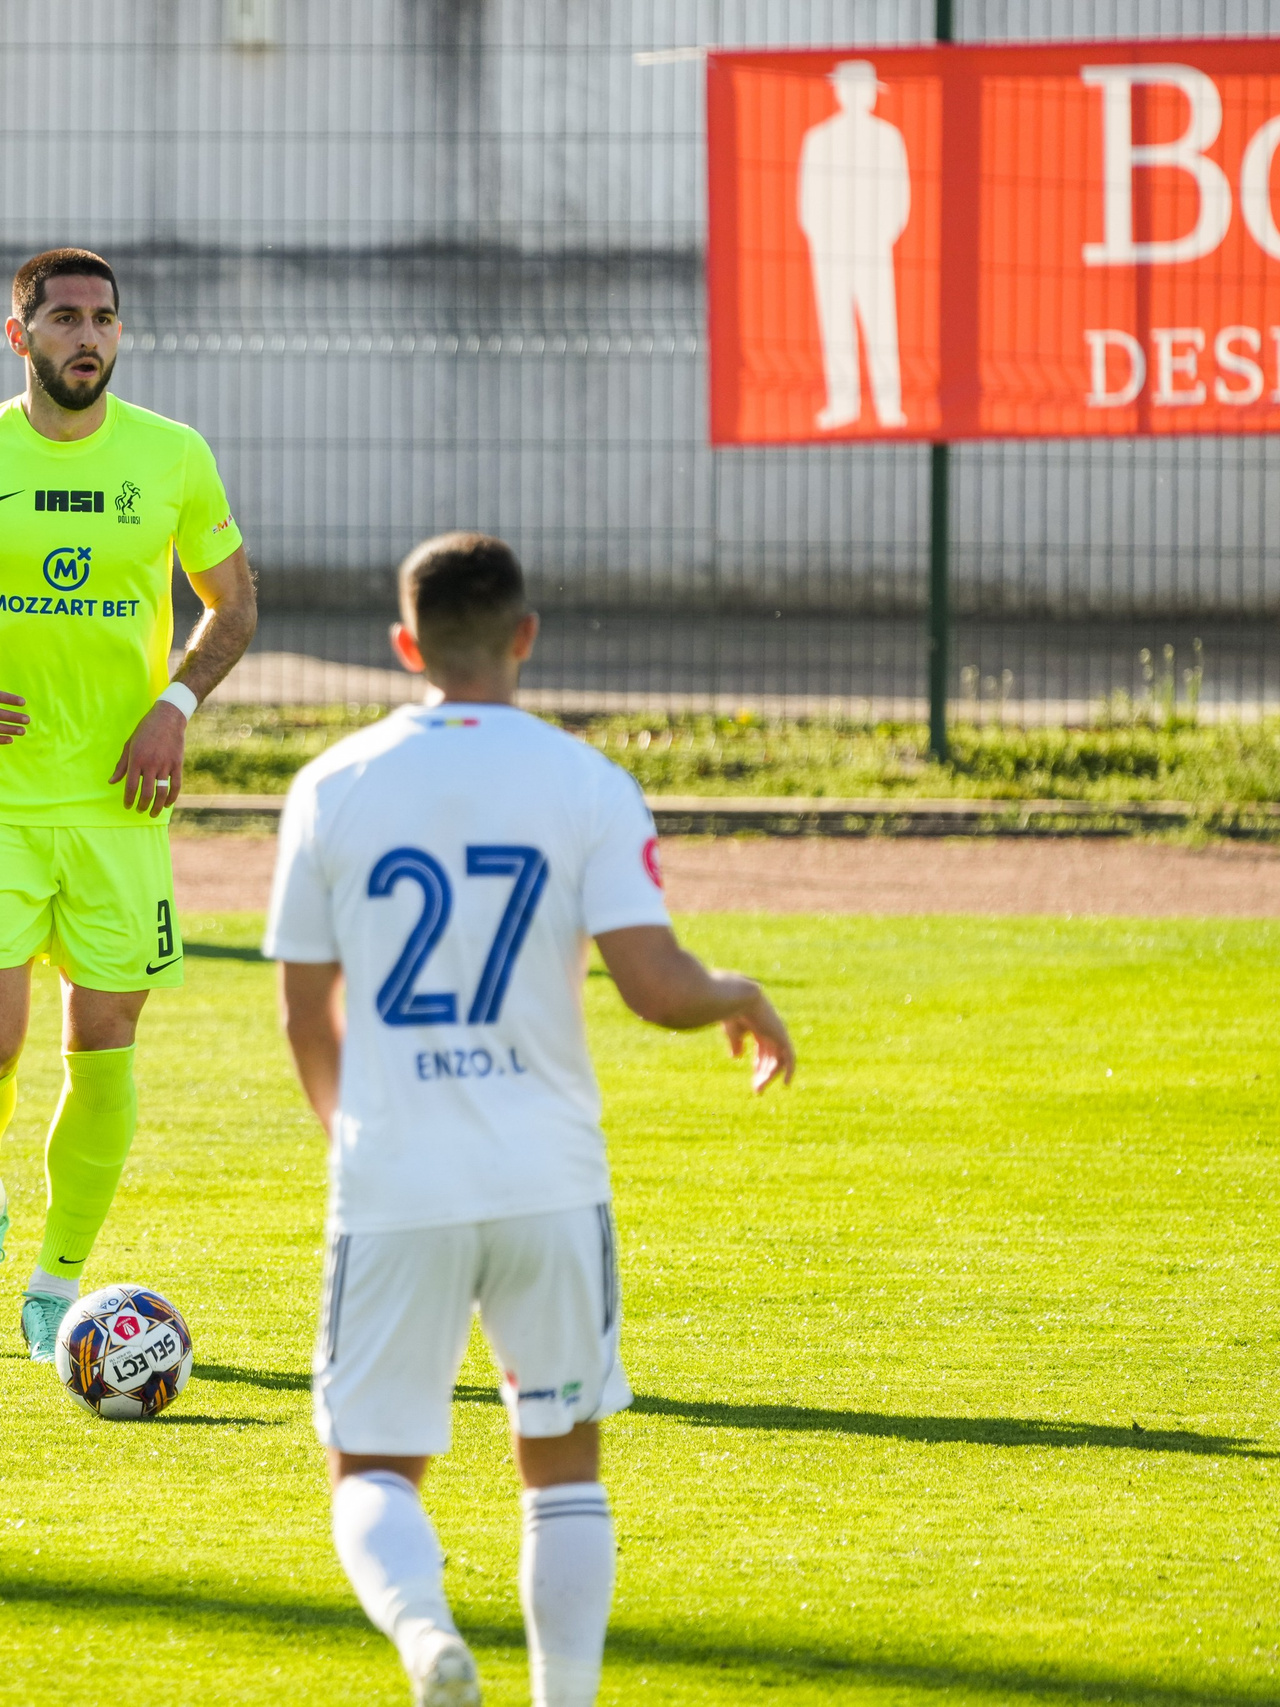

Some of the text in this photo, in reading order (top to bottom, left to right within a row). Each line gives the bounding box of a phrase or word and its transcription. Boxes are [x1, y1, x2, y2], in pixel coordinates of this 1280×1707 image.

[1084, 325, 1280, 408] DES
[35, 490, 104, 513] IASI
[102, 600, 140, 618] BET
[157, 898, 174, 959] 3
[366, 845, 549, 1029] 27
[112, 1333, 176, 1384] SELECT
